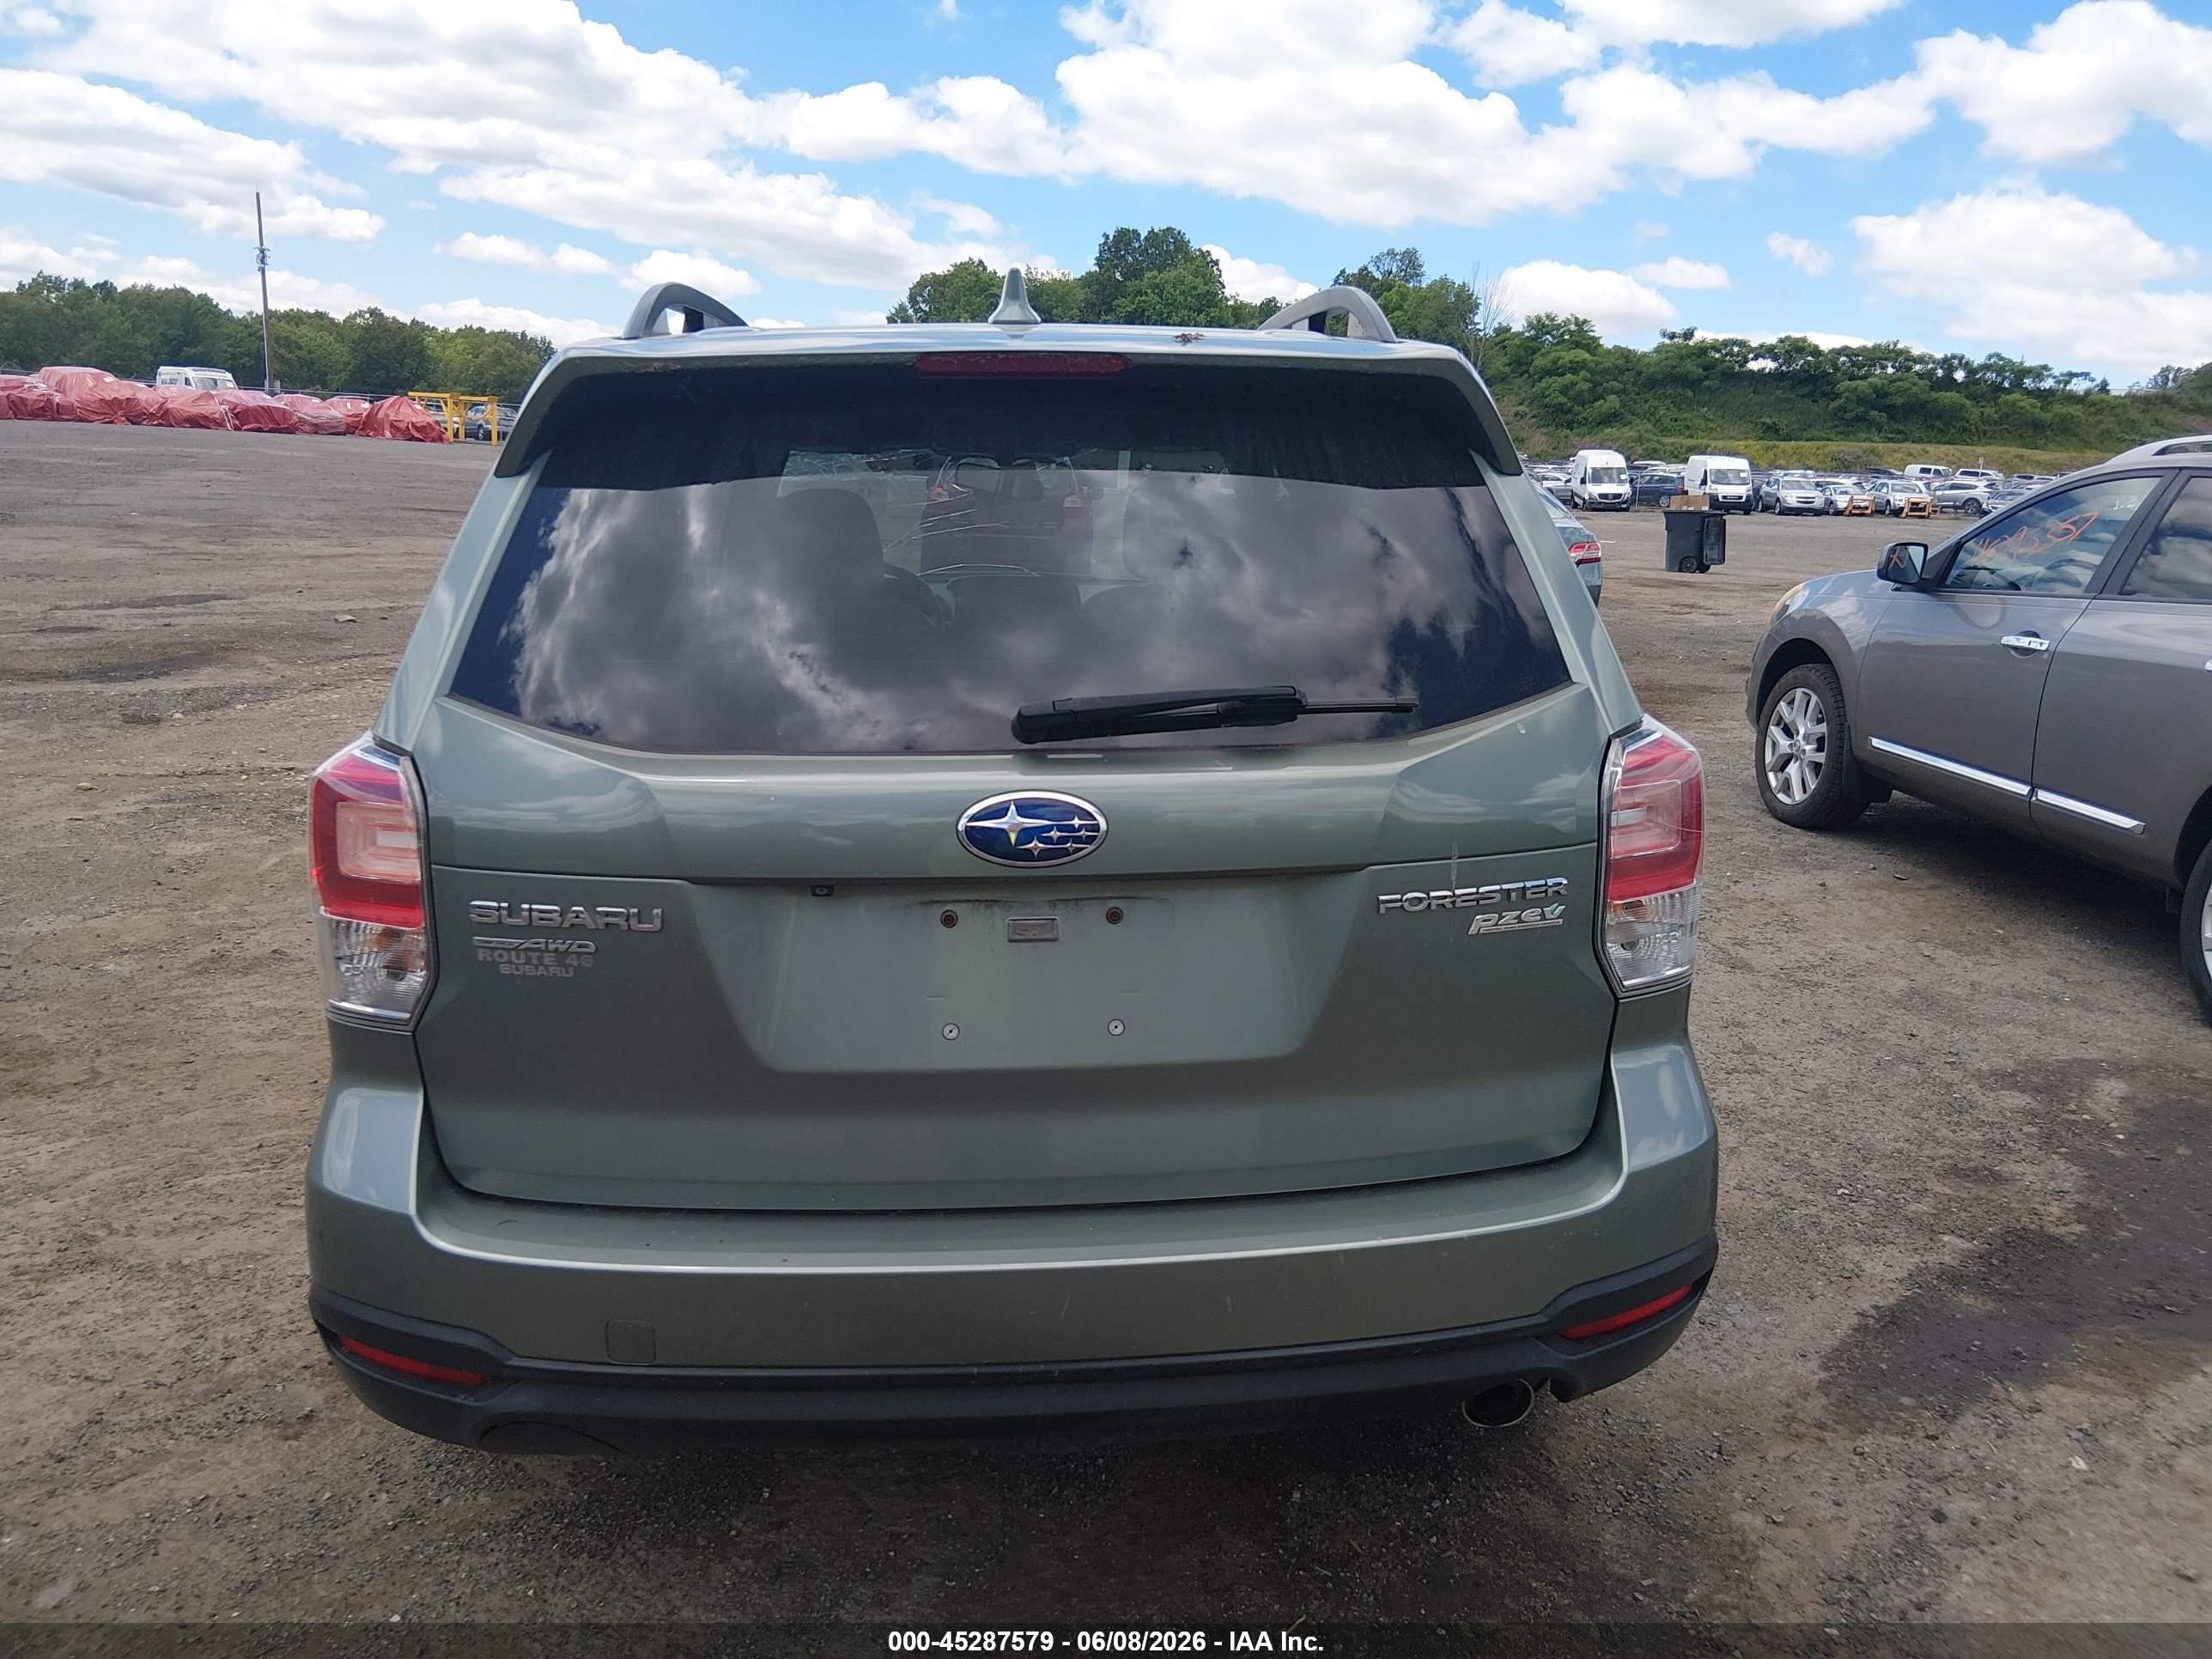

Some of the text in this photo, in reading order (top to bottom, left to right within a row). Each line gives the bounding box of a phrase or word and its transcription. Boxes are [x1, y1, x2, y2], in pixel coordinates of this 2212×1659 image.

[1377, 877, 1568, 915] FORESTER
[470, 900, 663, 932] SUBARU
[477, 948, 558, 965] ROUTE
[499, 963, 574, 977] SUBARU
